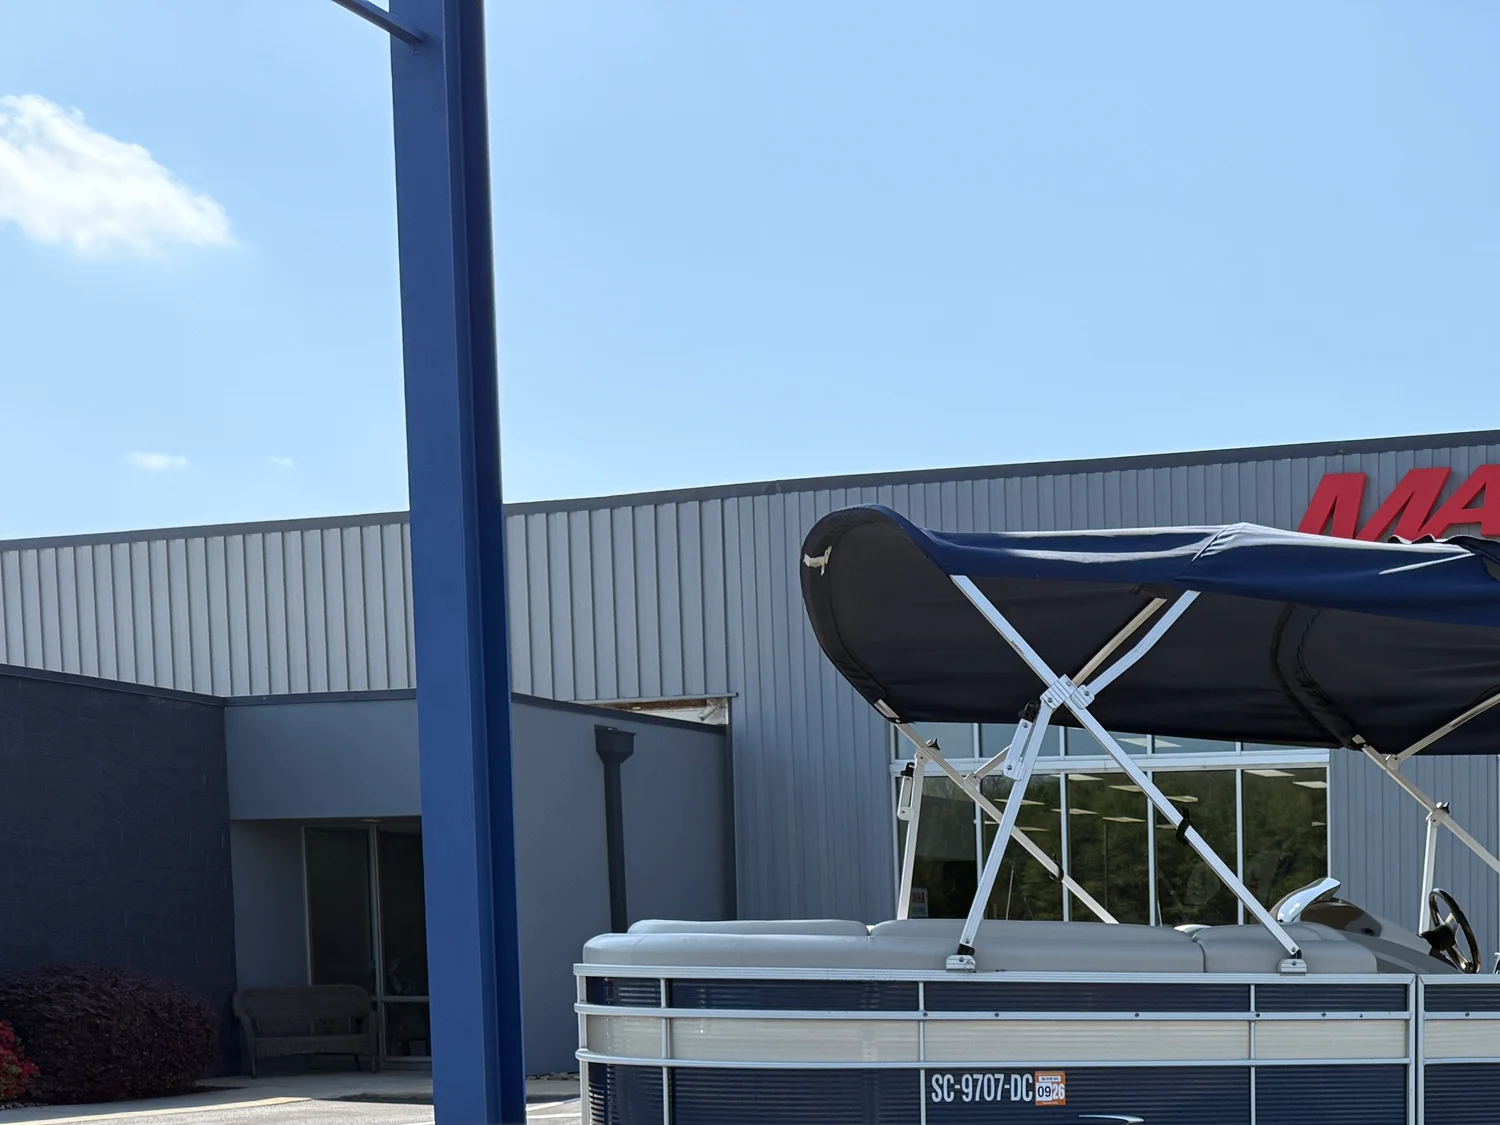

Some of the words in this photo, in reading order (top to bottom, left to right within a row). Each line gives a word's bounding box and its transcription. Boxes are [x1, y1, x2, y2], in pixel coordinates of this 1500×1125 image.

[931, 1073, 1034, 1103] SC-9707-DC
[1037, 1085, 1052, 1098] 09
[1052, 1083, 1066, 1100] 26
